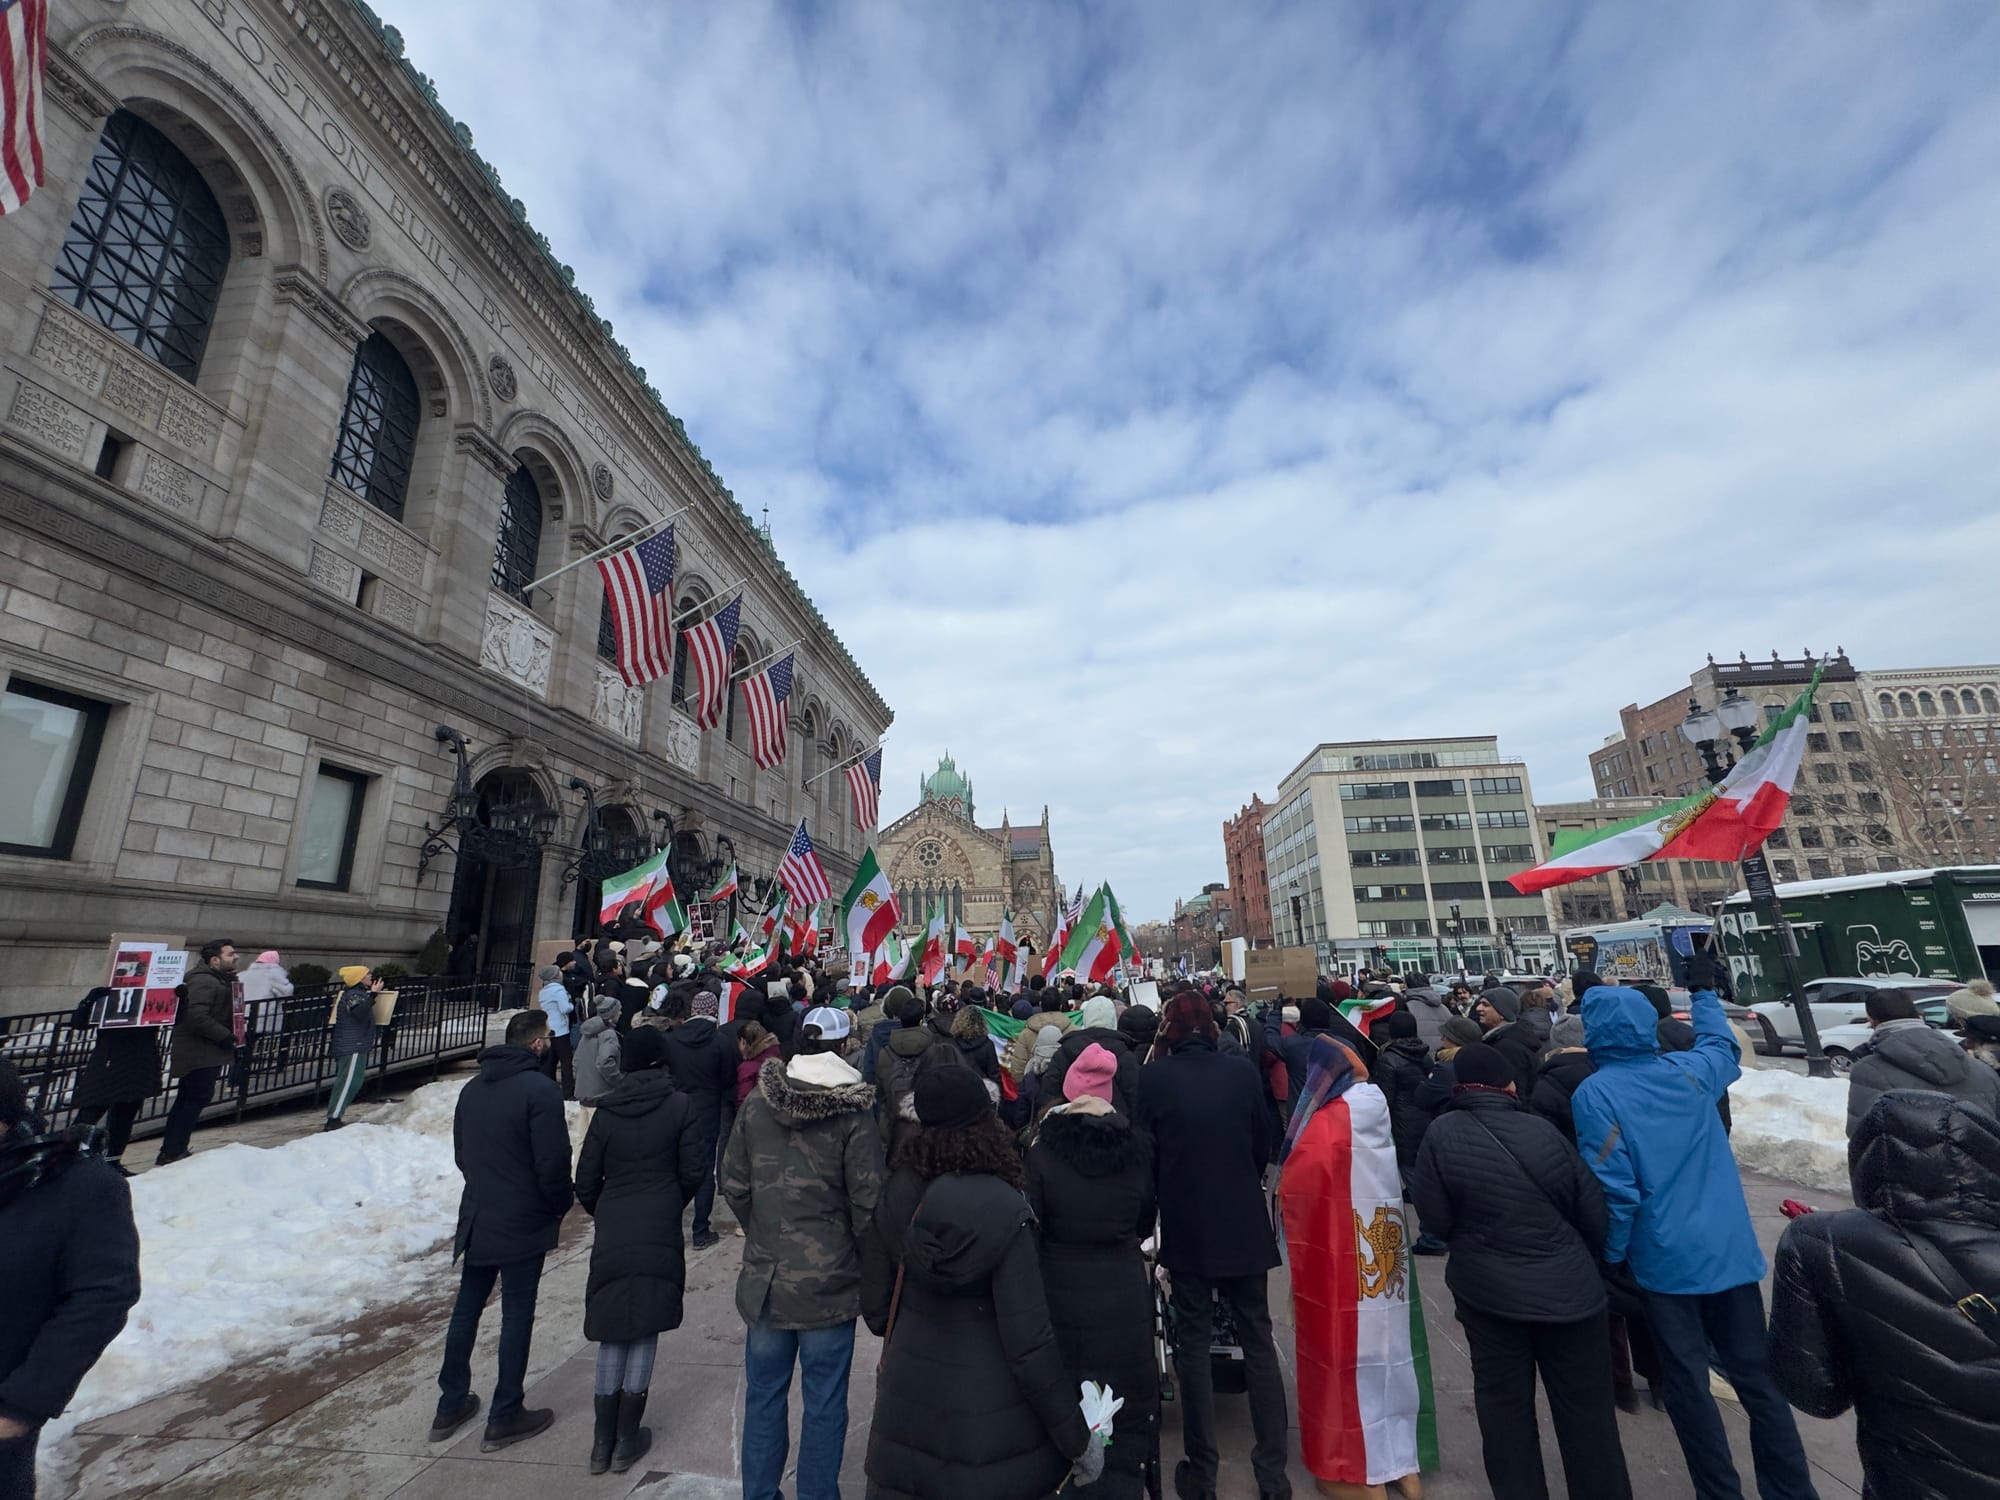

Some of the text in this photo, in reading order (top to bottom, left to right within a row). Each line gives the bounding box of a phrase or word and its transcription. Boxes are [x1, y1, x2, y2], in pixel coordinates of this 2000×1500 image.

[203, 0, 372, 185] BOSTON
[389, 193, 467, 286] BUILT
[480, 295, 513, 329] BY
[525, 344, 567, 403] THE
[576, 402, 631, 476] PEOPLE
[640, 478, 666, 512] AND
[41, 328, 93, 363] KEPLER
[47, 308, 106, 350] GALILEO
[23, 386, 70, 415] GALEN
[160, 424, 193, 449] EVANS
